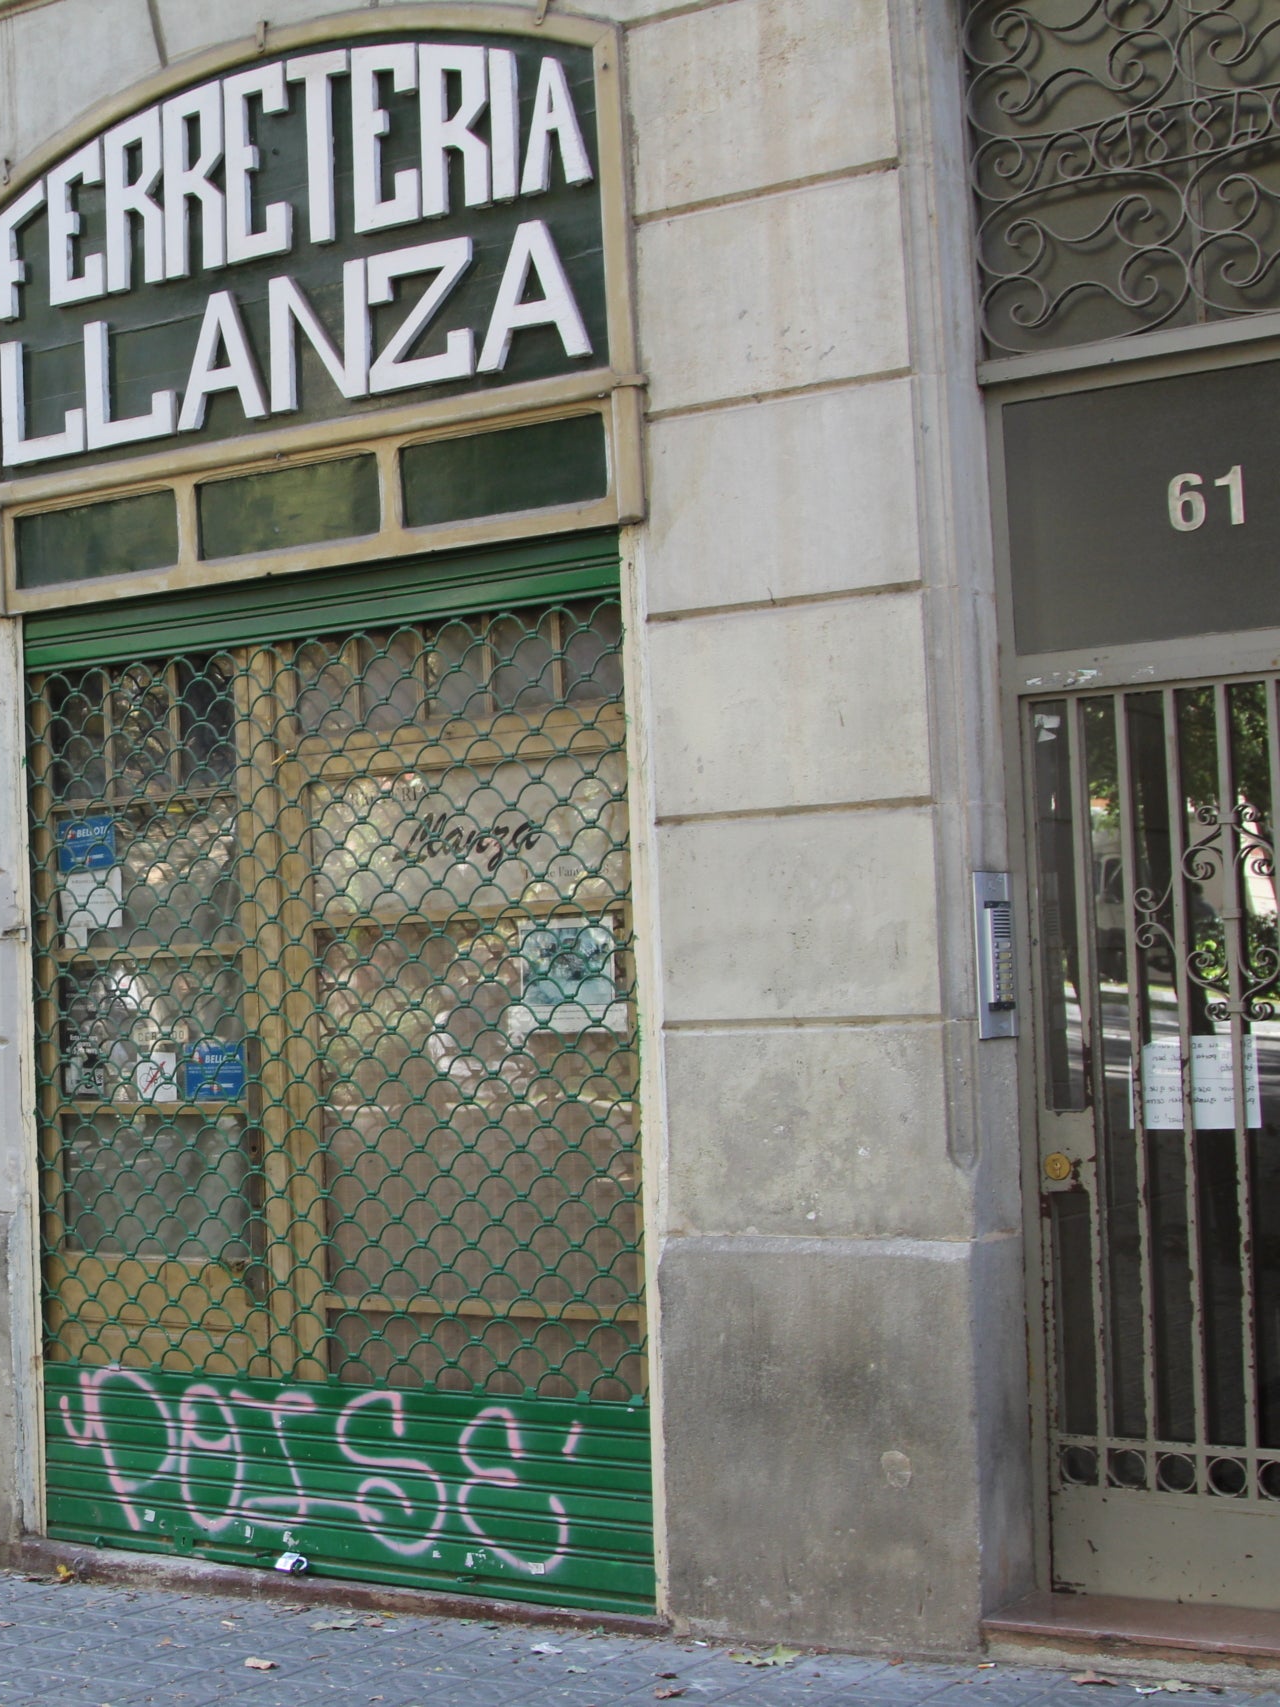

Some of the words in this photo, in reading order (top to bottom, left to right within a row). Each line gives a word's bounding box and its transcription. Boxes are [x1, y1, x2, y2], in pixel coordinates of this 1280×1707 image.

[0, 219, 594, 467] LLANZA
[1168, 465, 1245, 532] 61
[76, 825, 111, 839] BELOTA
[137, 1030, 186, 1043] CERDO
[205, 1054, 241, 1064] BELLA
